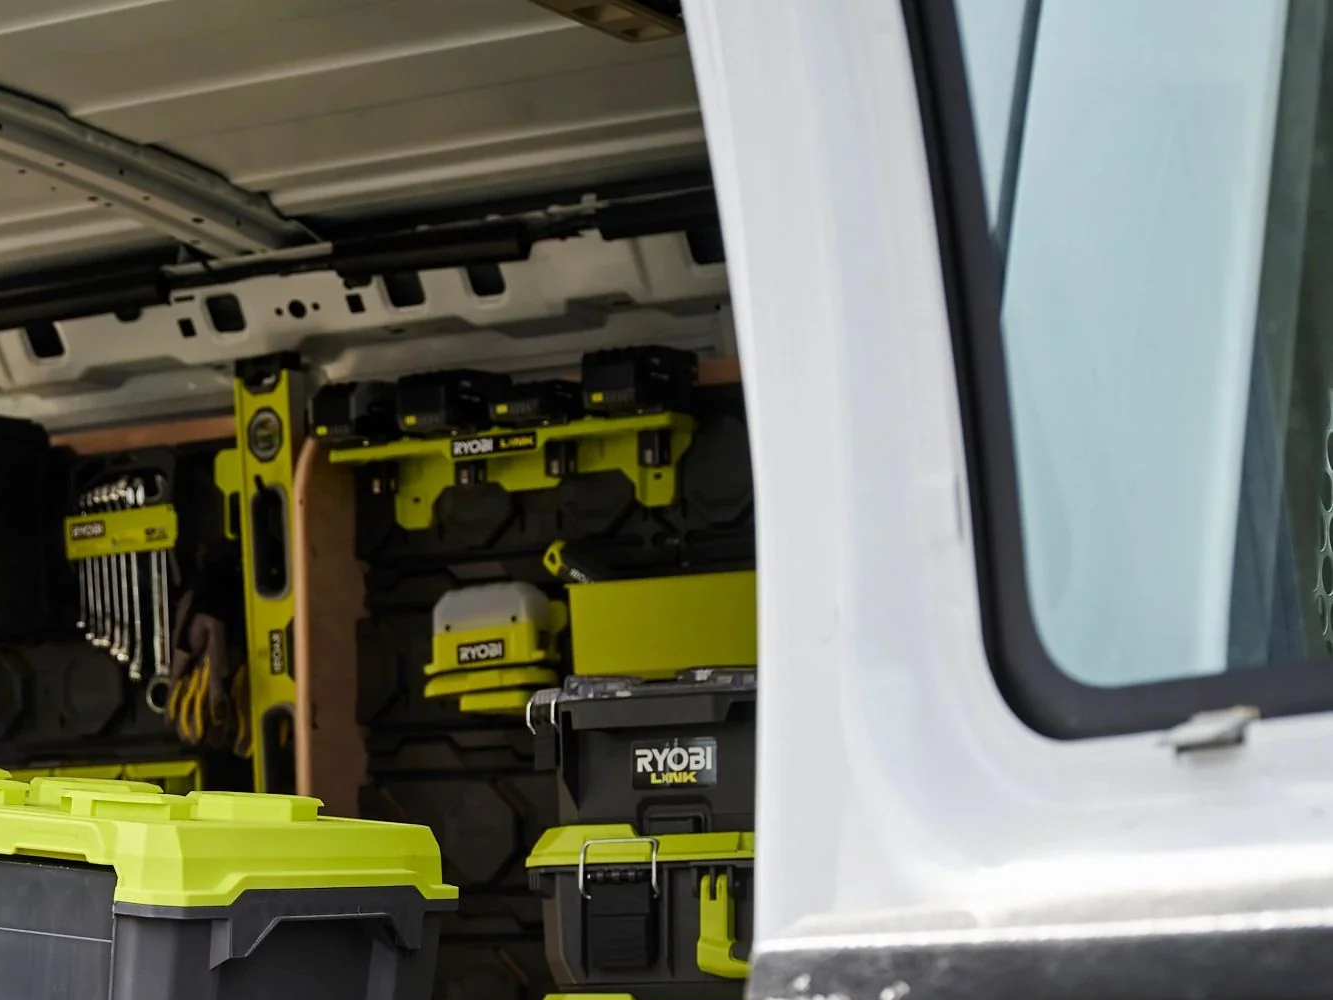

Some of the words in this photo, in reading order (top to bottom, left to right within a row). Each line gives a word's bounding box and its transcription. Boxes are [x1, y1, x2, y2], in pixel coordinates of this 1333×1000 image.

[453, 437, 494, 456] RYOBI
[459, 641, 503, 661] RYOBI
[635, 746, 713, 773] RYOBI
